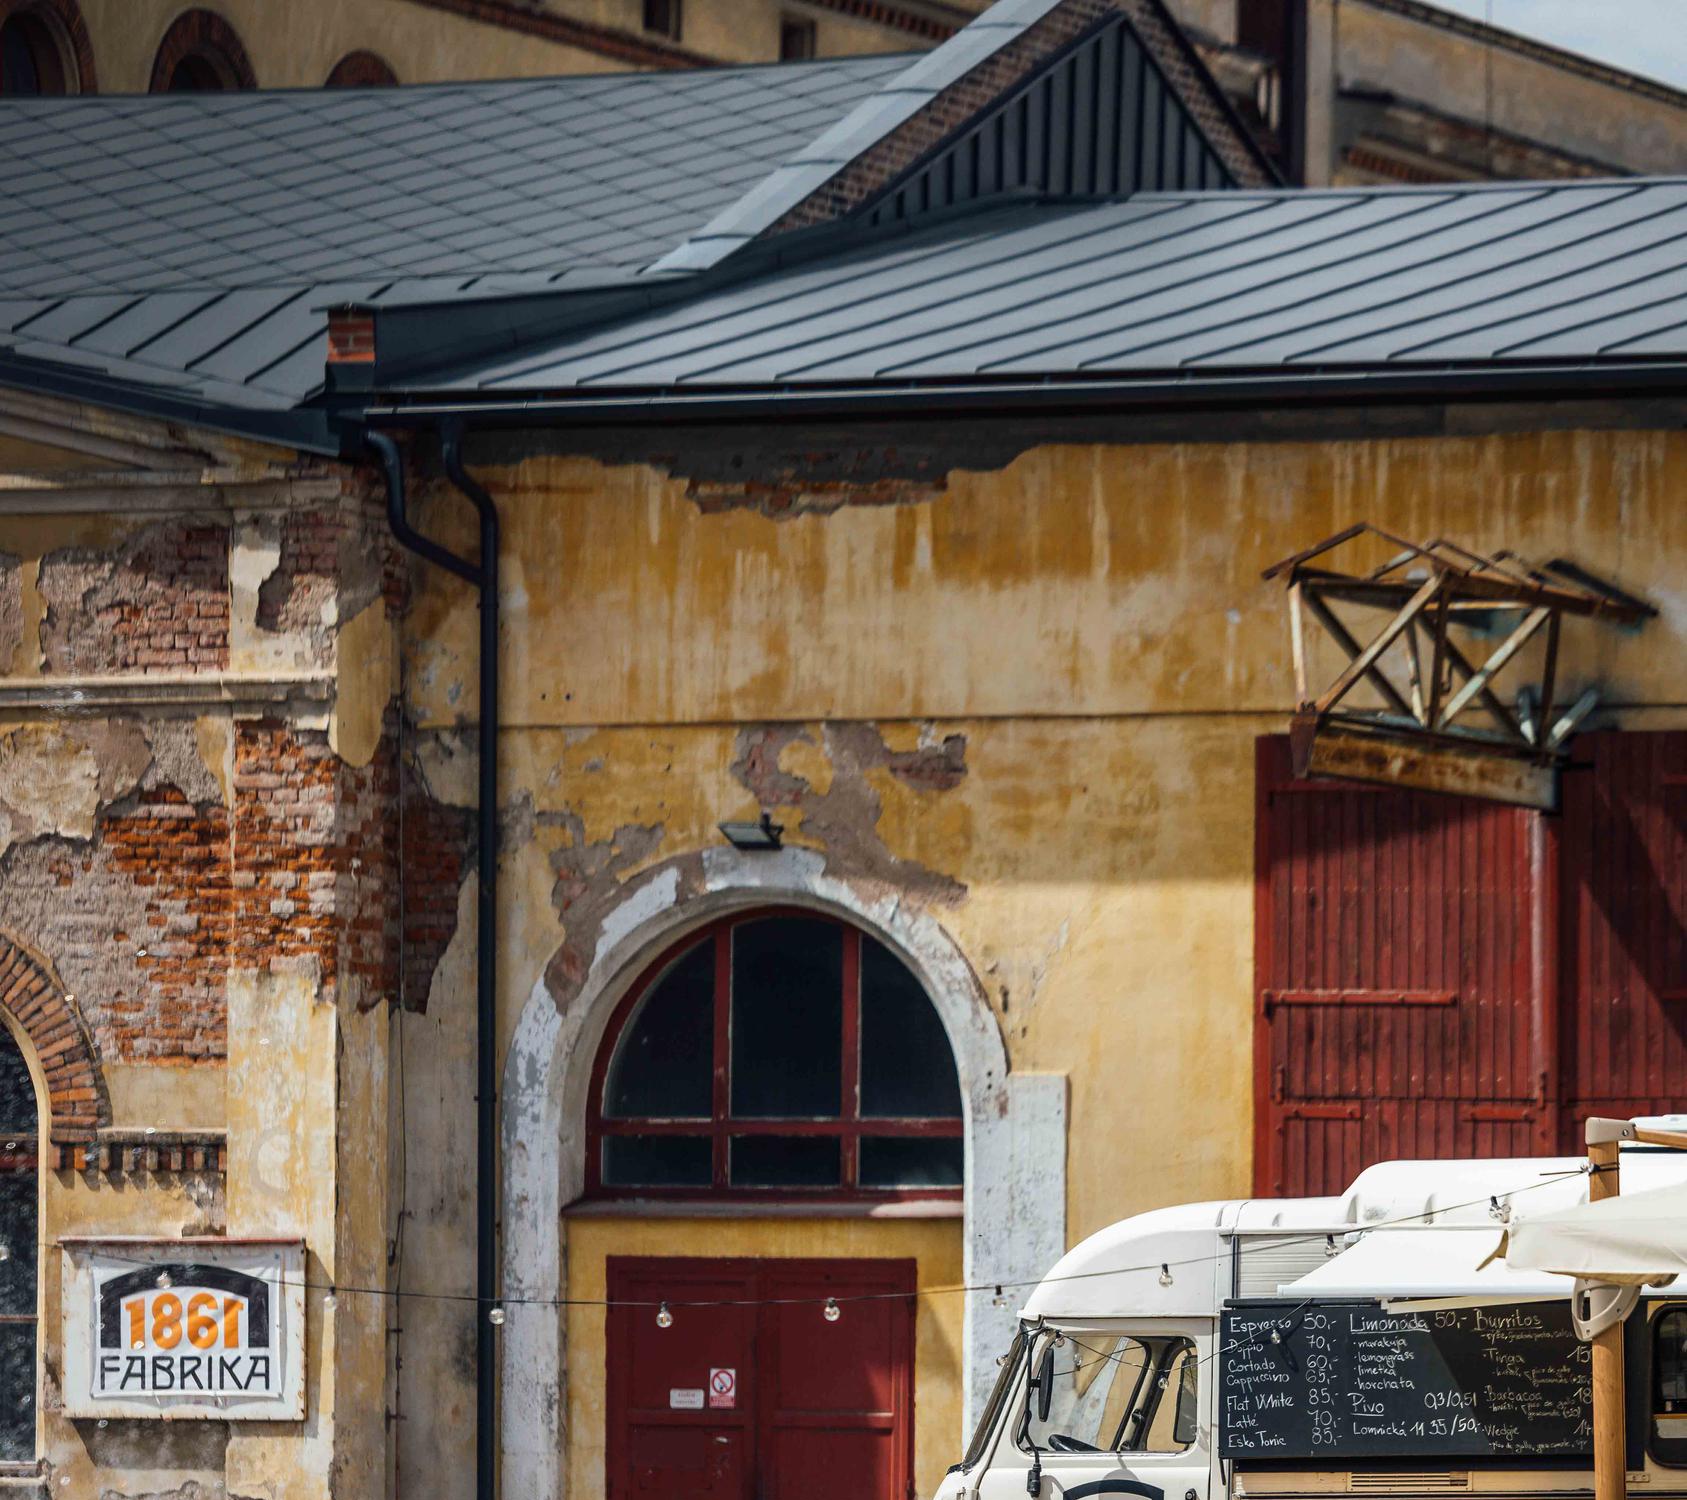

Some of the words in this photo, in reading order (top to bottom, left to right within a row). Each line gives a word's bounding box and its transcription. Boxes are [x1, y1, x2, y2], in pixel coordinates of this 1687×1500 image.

[125, 1293, 244, 1350] 1861
[1350, 1313, 1428, 1332] Limonáda
[1474, 1308, 1542, 1329] Burritos
[1230, 1317, 1292, 1343] Espresso
[1228, 1339, 1264, 1360] Doppio
[1358, 1336, 1408, 1353] marakuja
[1227, 1357, 1276, 1372] Cortado
[1357, 1351, 1415, 1369] lemongrass
[100, 1355, 270, 1391] FABRIKA
[1226, 1370, 1290, 1394] Cappuccino
[1357, 1376, 1415, 1390] horchata
[1226, 1395, 1250, 1413] Flat
[1255, 1392, 1295, 1410] White
[1347, 1392, 1385, 1414] Pivo
[1228, 1434, 1255, 1448] Esko
[1255, 1430, 1287, 1447] Tonic
[1353, 1421, 1407, 1437] Lomnická
